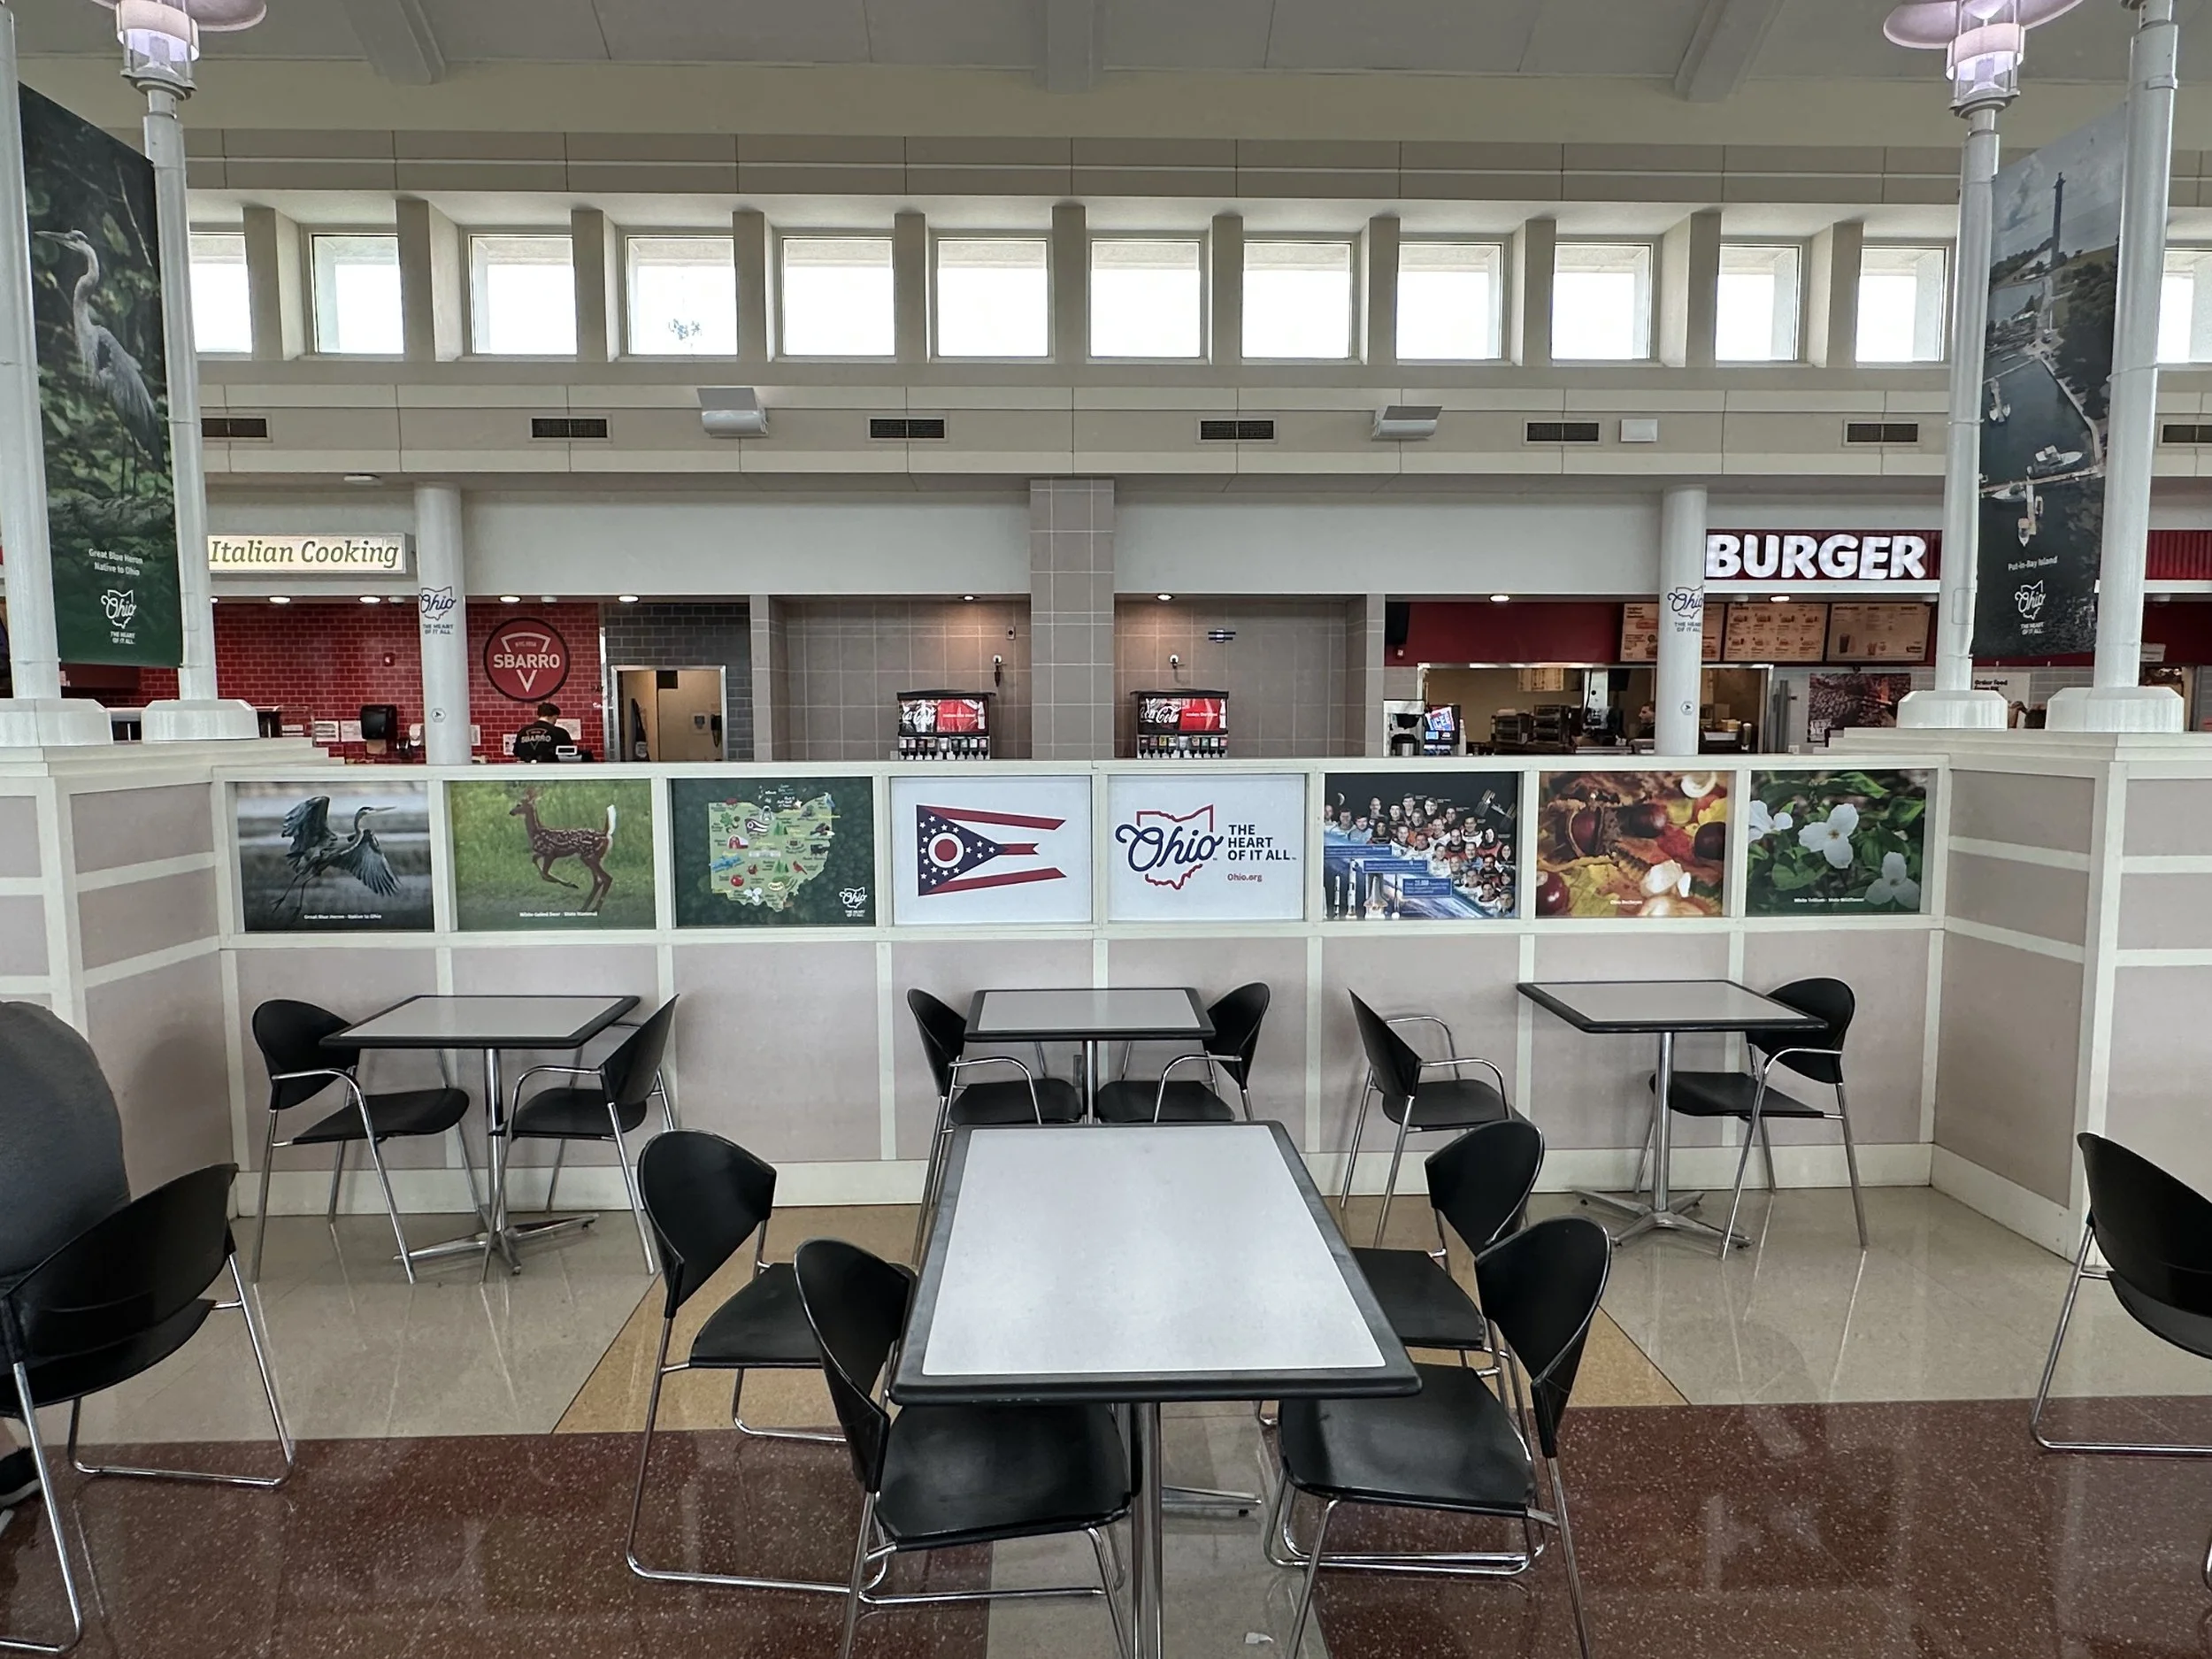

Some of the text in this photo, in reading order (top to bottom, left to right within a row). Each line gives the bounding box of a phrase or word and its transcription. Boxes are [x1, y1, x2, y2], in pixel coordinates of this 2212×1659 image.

[88, 549, 108, 558] Great
[108, 551, 124, 561] Blue
[209, 540, 399, 569] Italian Cooking
[1705, 534, 1926, 580] BURGER
[94, 562, 117, 572] Native
[125, 566, 140, 576] Ohio
[2008, 556, 2058, 571] Put-in-Bay Island
[100, 595, 137, 619] Ohio
[419, 594, 457, 613] Ohio
[2015, 589, 2047, 613] Ohio
[493, 653, 561, 669] SBARRO
[520, 734, 552, 743] SBARRO
[1228, 825, 1256, 835] THE
[1115, 824, 1224, 872] Ohio
[1228, 837, 1273, 848] HEART
[1227, 849, 1290, 861] OF IT ALL
[1227, 872, 1263, 883] Ohio.org
[839, 891, 868, 904] Ohio
